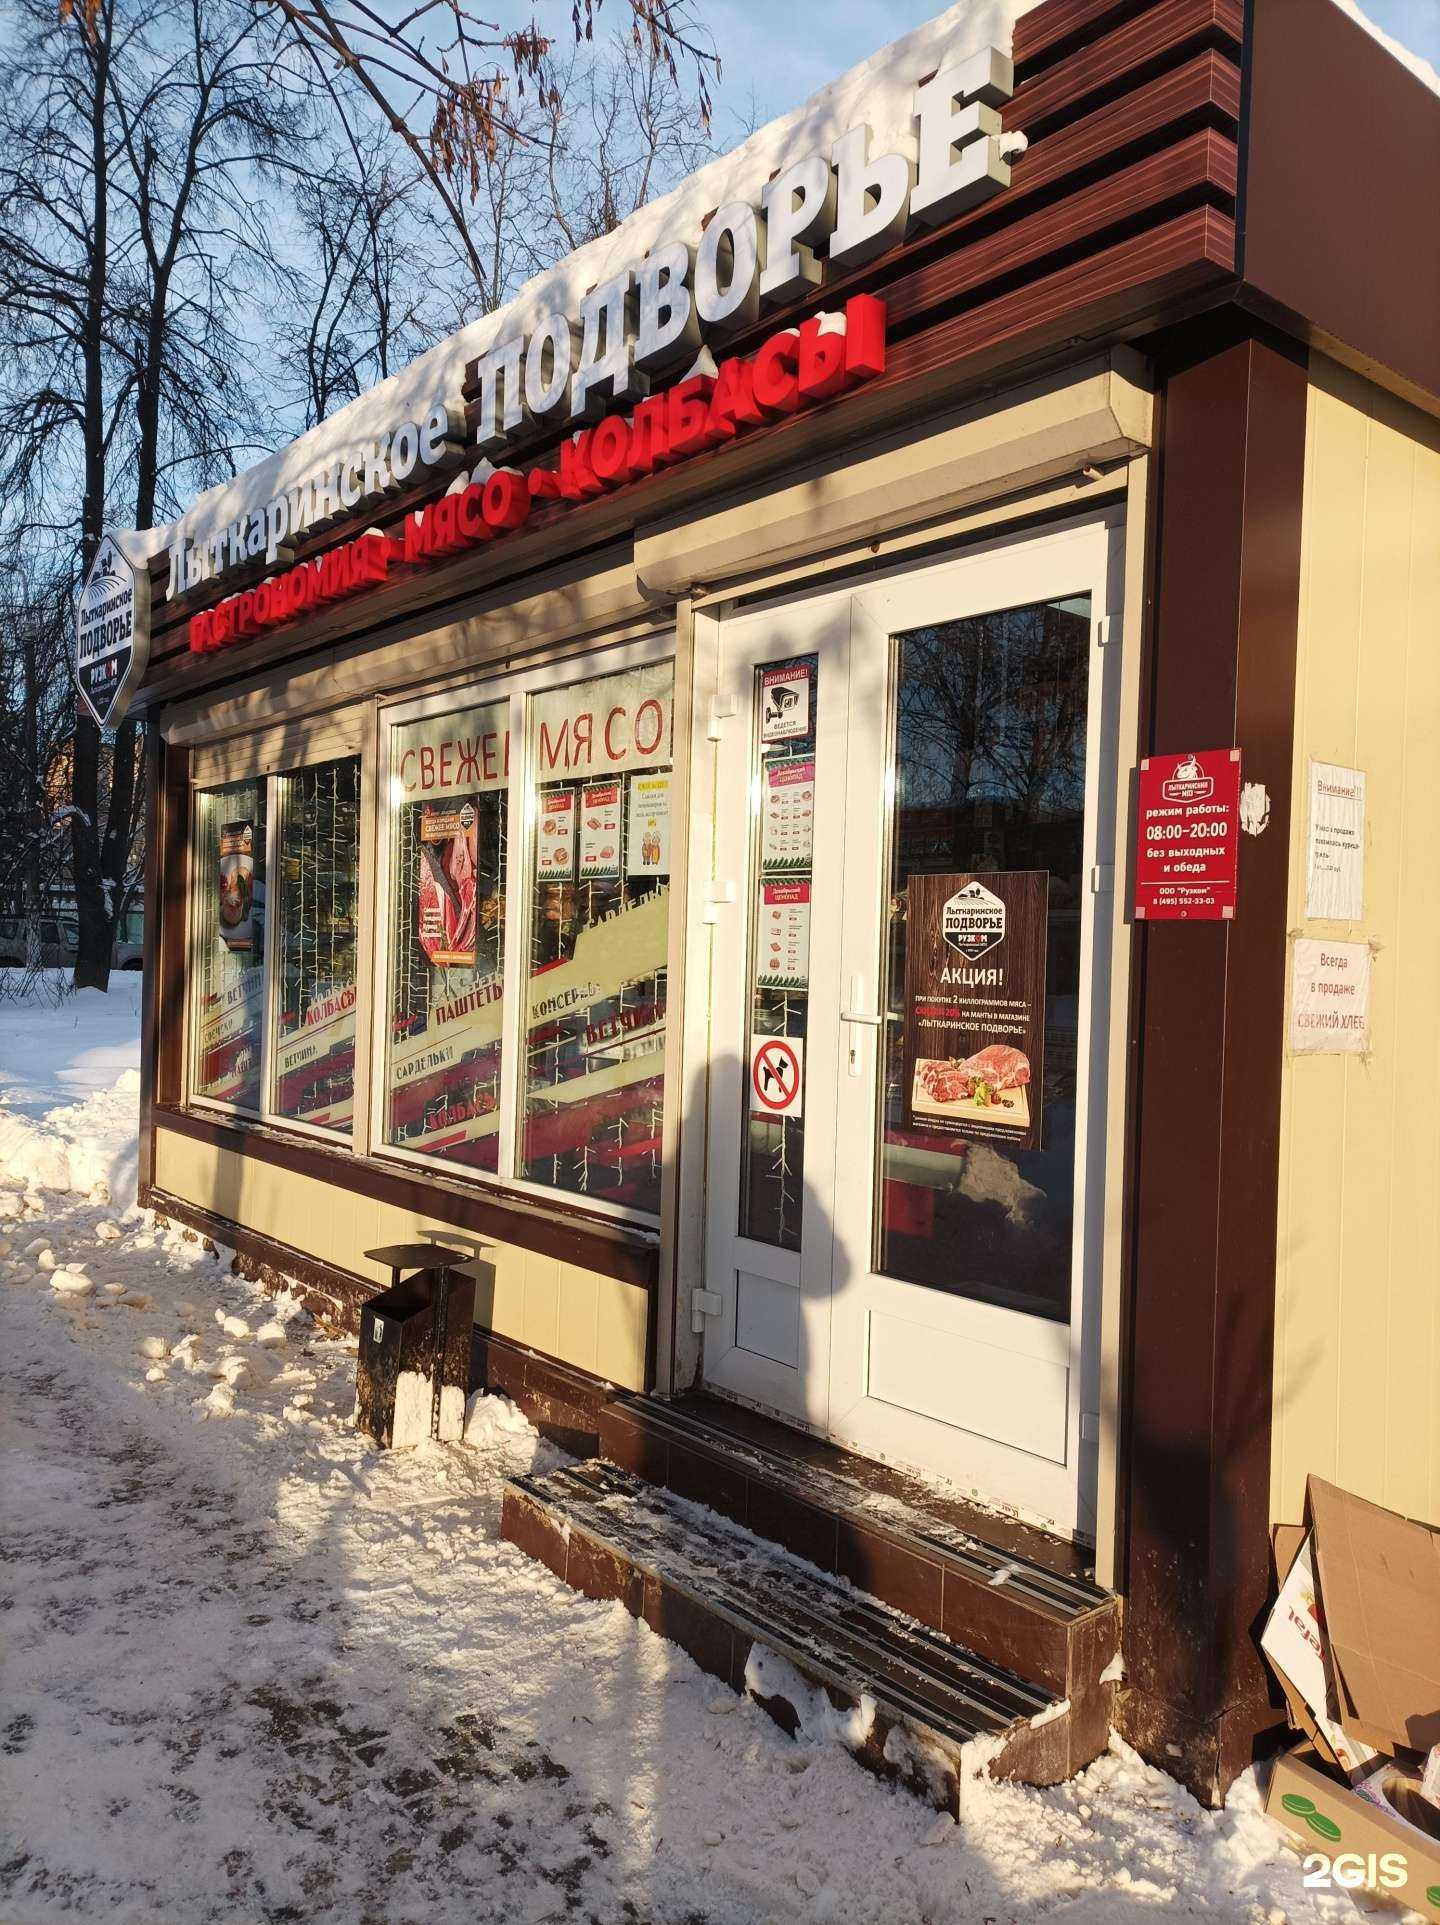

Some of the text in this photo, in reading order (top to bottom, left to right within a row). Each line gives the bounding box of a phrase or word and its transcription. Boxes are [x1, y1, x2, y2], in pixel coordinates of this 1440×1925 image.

[166, 46, 1013, 600] Лыткаринское ПОДВОРЬЕ
[189, 294, 886, 653] ГАСТРОНОМИЯ МЯСО КОЛБАСЫ
[80, 610, 132, 659] ПОДВОРЬЕ
[765, 668, 808, 686] ВНИМАНИЕ!
[540, 699, 663, 771] МЯСО
[1146, 804, 1229, 819] режим работы:
[1146, 822, 1228, 840] 08:00-20:00
[1147, 846, 1225, 857] без выходных
[1163, 863, 1206, 873] и обеда
[1159, 887, 1175, 895] ООО
[946, 906, 1003, 917] Лыткаринское
[945, 918, 1003, 931] ПОДВОРЬЕ
[958, 934, 988, 944] РУЗКОМ
[1320, 953, 1348, 972] Всегда
[940, 968, 1003, 988] АКЦИЯ!
[1311, 982, 1355, 997] в продаже
[952, 995, 958, 1004] 2
[998, 1013, 1031, 1022] МАГАЗИНЕ
